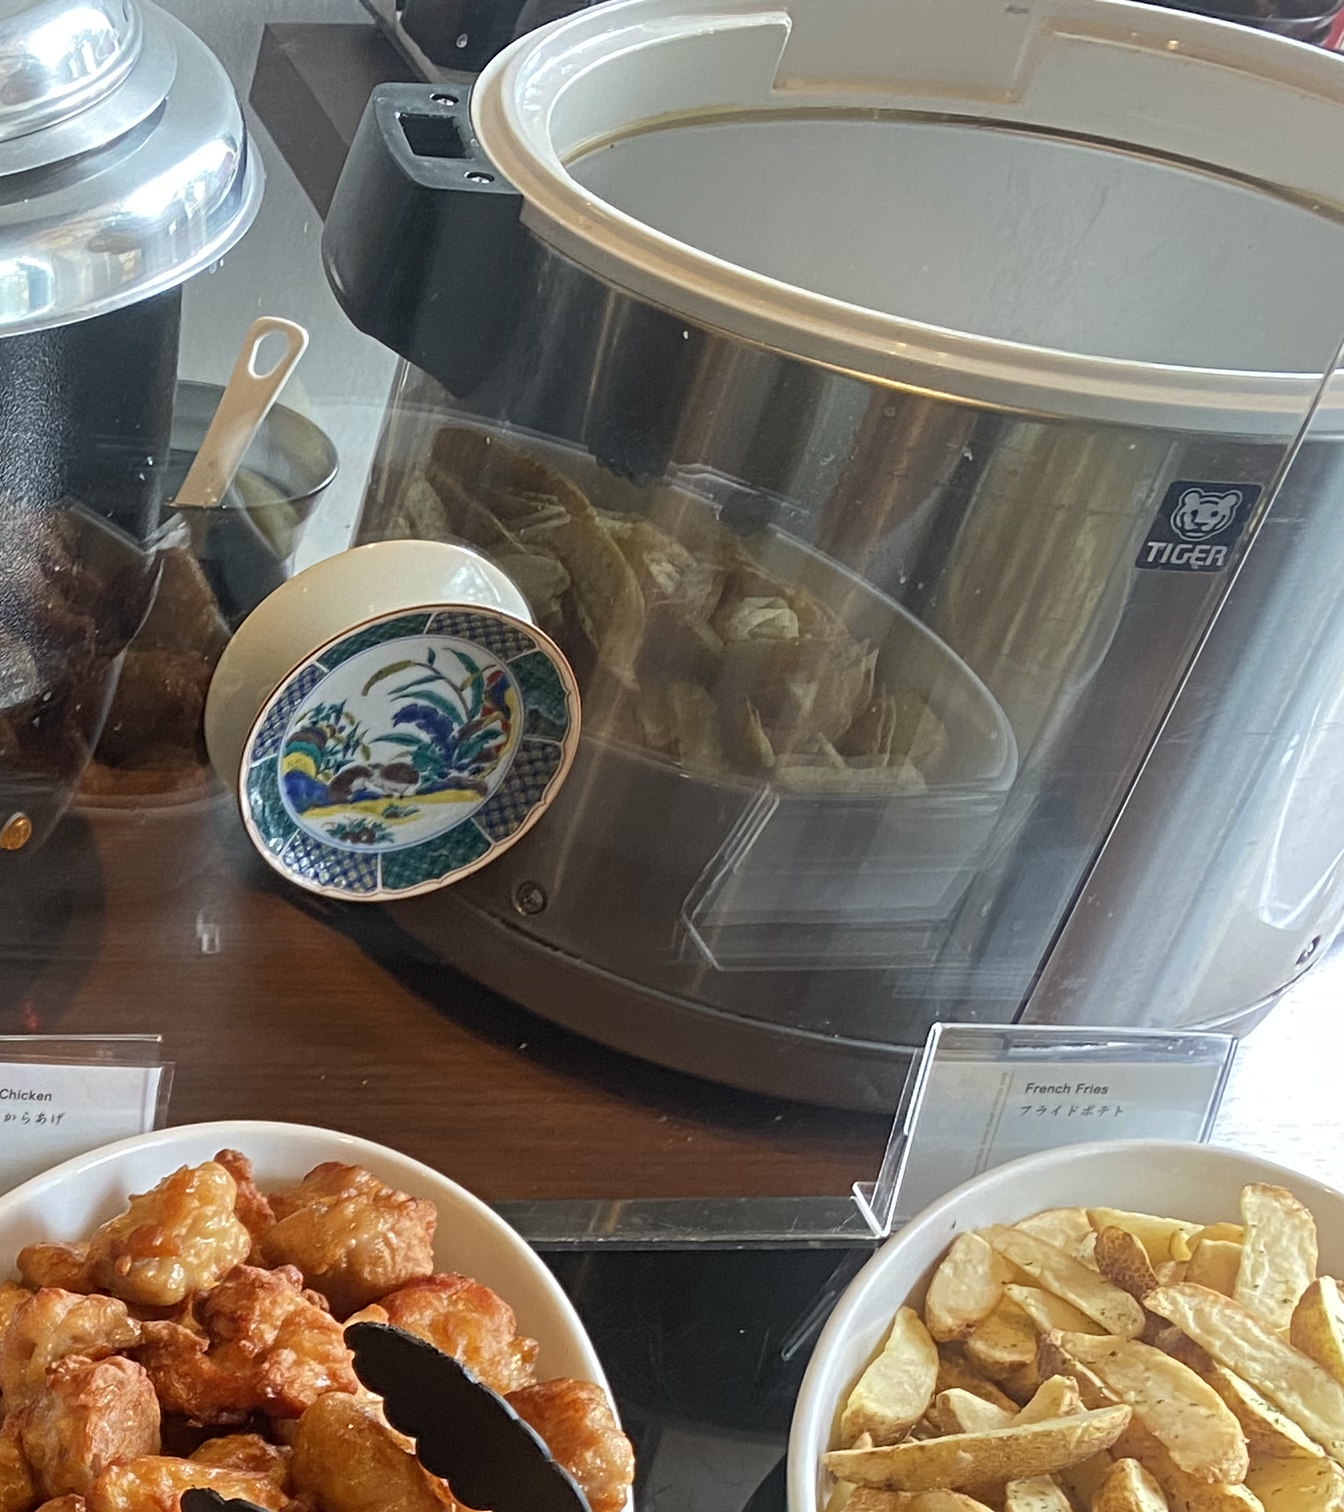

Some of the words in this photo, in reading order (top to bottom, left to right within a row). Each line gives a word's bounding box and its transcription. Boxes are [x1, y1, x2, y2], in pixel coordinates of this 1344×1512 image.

[1146, 541, 1228, 568] TIGER
[0, 1088, 52, 1102] Chicken
[1025, 1082, 1070, 1095] French
[1075, 1083, 1108, 1096] Fries
[1019, 1104, 1124, 1118] フライドポテト
